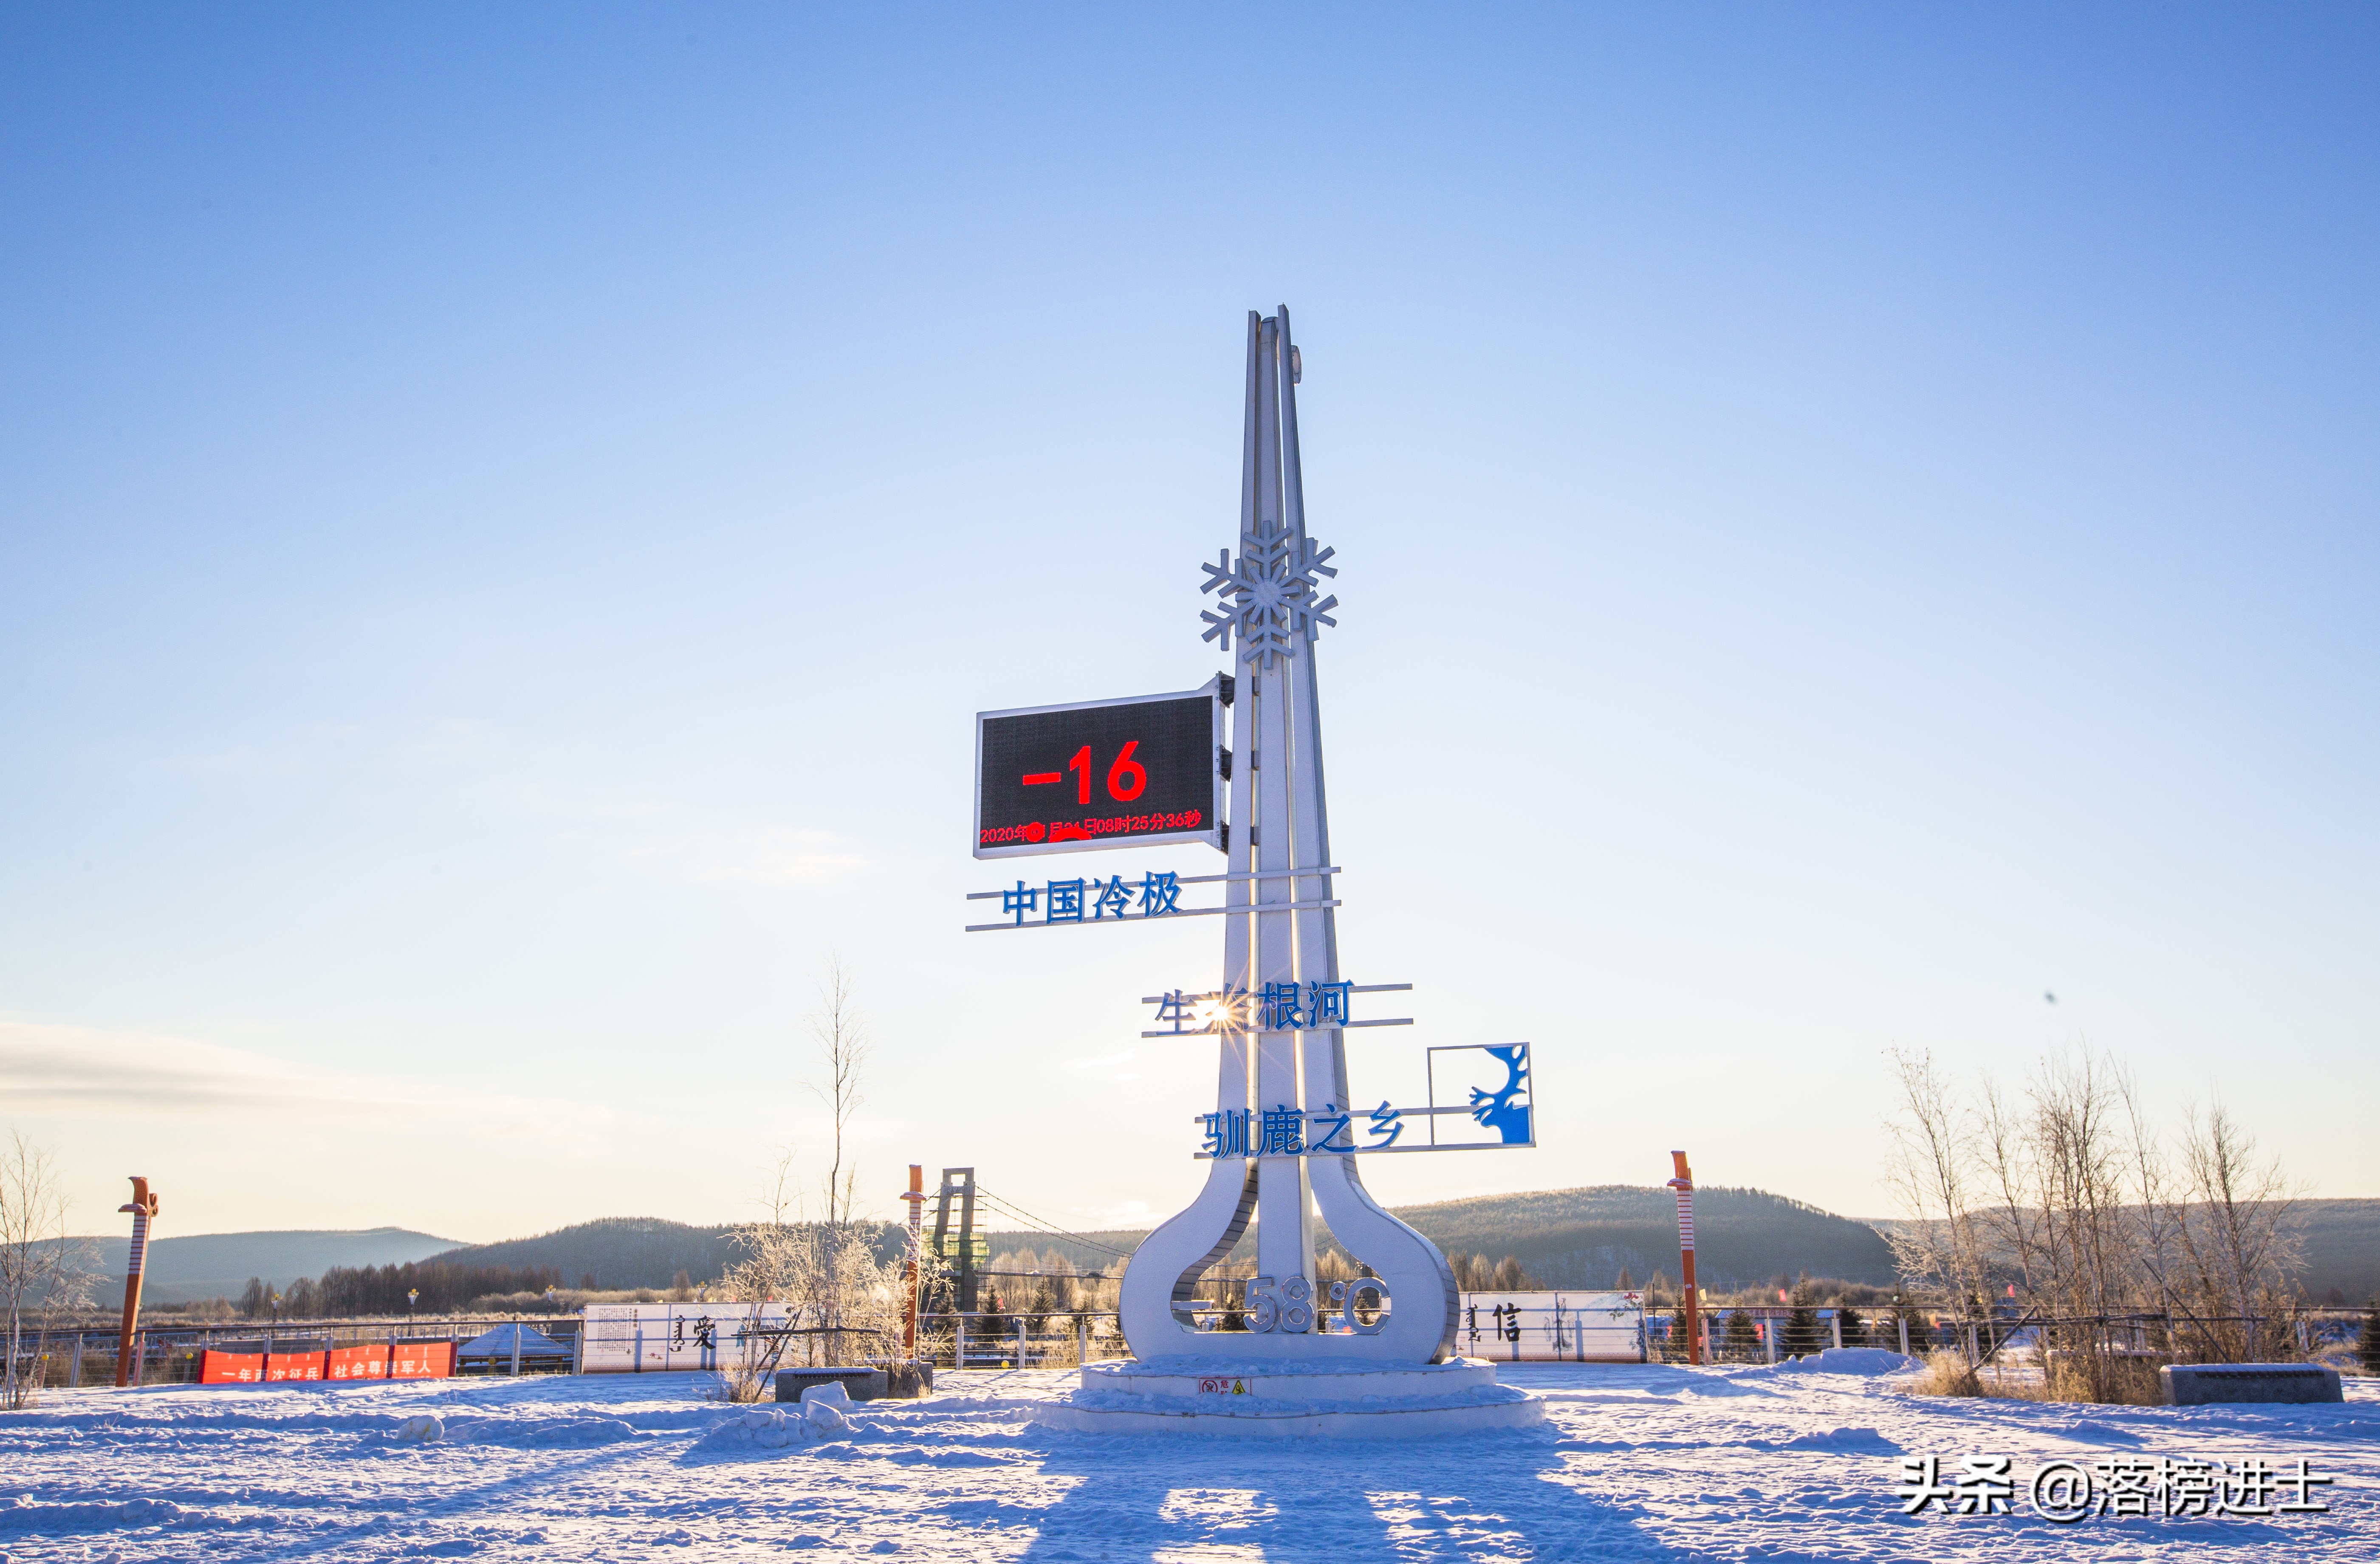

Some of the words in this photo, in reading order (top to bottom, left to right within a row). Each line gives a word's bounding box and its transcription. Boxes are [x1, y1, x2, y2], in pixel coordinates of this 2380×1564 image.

[1022, 741, 1146, 804] -16
[1003, 871, 1182, 926] 中国冷极
[1155, 979, 1355, 1036] 生态根河
[1202, 1100, 1404, 1159] 驯鹿之乡
[693, 1315, 716, 1350] 愛
[1492, 1302, 1522, 1342] 信
[222, 1367, 319, 1382] 一年两次征兵
[334, 1360, 431, 1378] 社会尊崇军人
